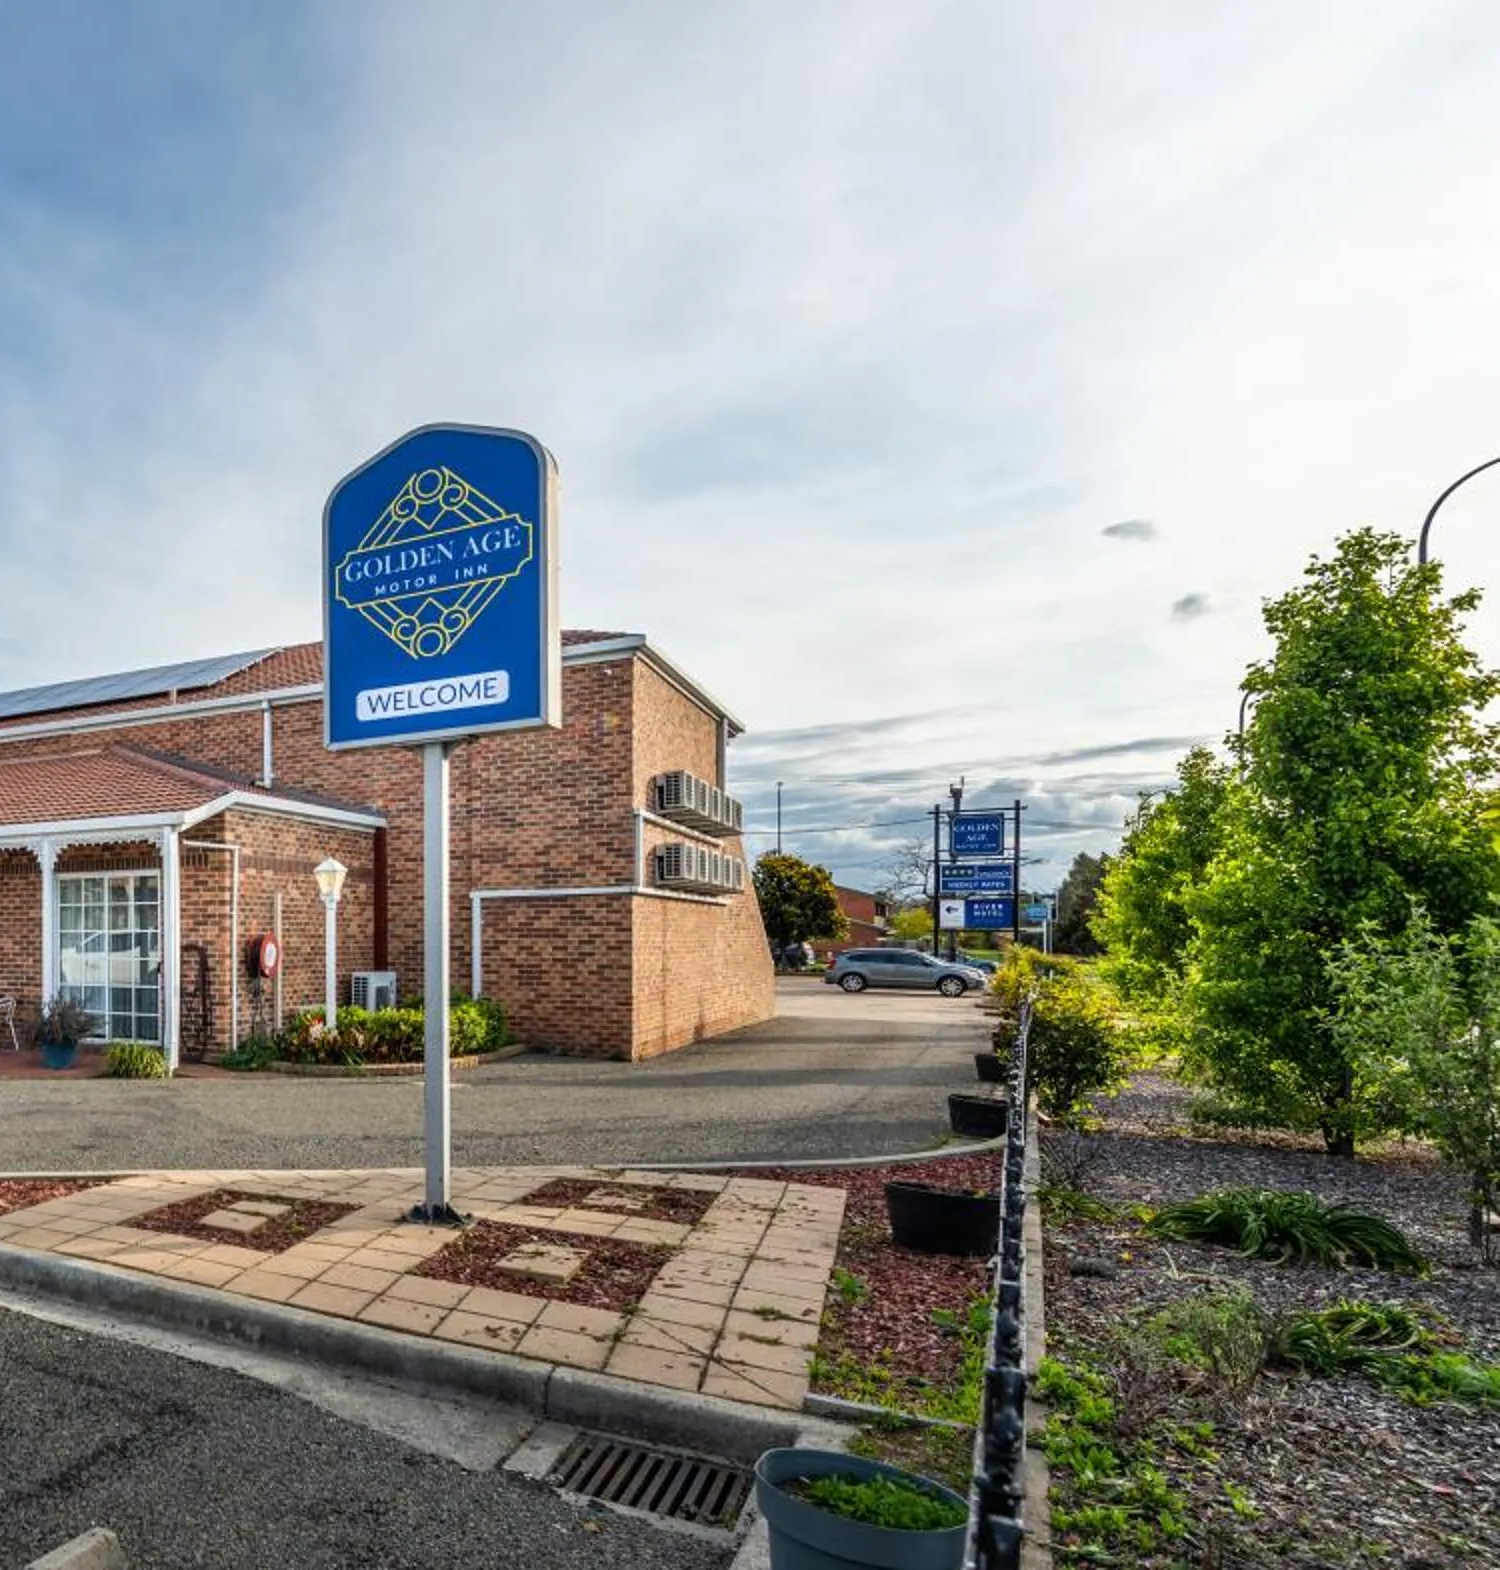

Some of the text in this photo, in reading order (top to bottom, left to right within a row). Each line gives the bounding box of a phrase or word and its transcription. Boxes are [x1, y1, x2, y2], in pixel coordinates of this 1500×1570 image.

[344, 525, 521, 582] GOLDEN AGE
[375, 563, 489, 596] MOTOR INN
[367, 677, 497, 714] WELCOME
